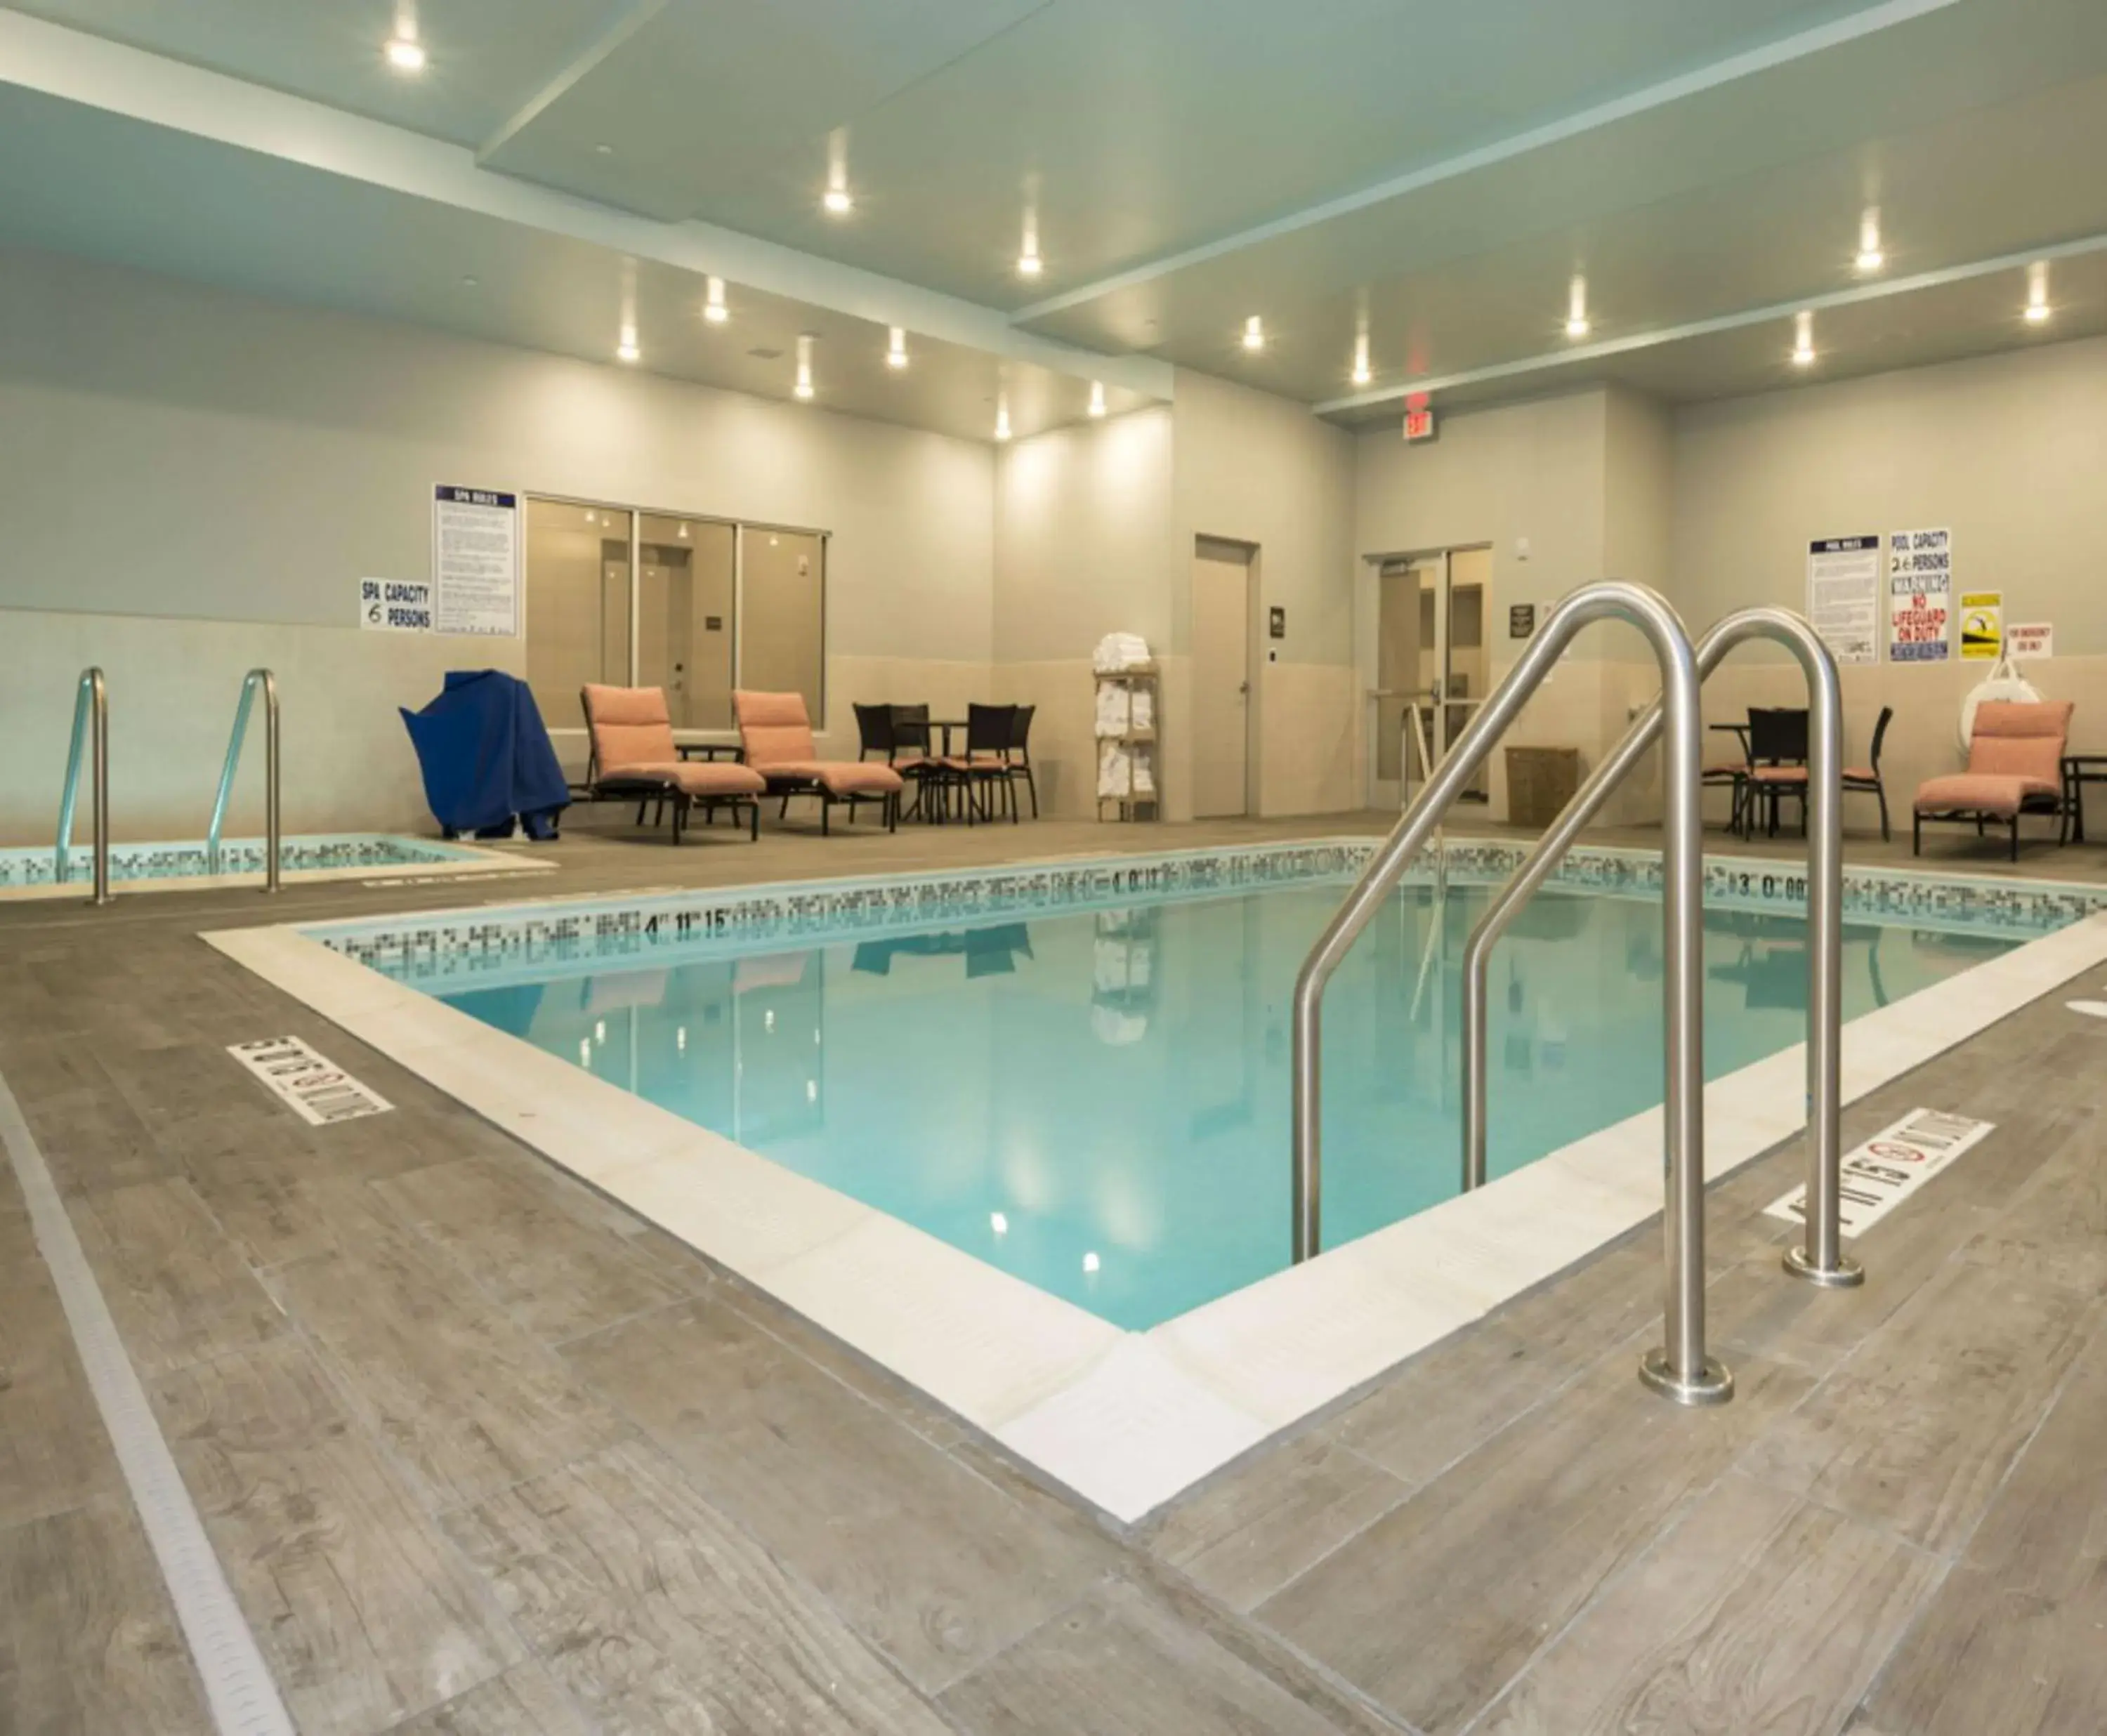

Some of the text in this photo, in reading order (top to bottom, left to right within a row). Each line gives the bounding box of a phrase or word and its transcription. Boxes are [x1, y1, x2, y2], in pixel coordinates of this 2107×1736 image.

[1407, 412, 1427, 436] EXIT
[1892, 530, 1948, 551] POOL CAPACITY
[1912, 553, 1949, 571] PERSONS
[362, 581, 429, 604] SPA CAPACITY
[1912, 593, 1927, 609] NO
[368, 603, 431, 629] 6 PERSONS
[1892, 608, 1946, 626] LIFEGUARD
[1898, 626, 1939, 642] ON DUTY
